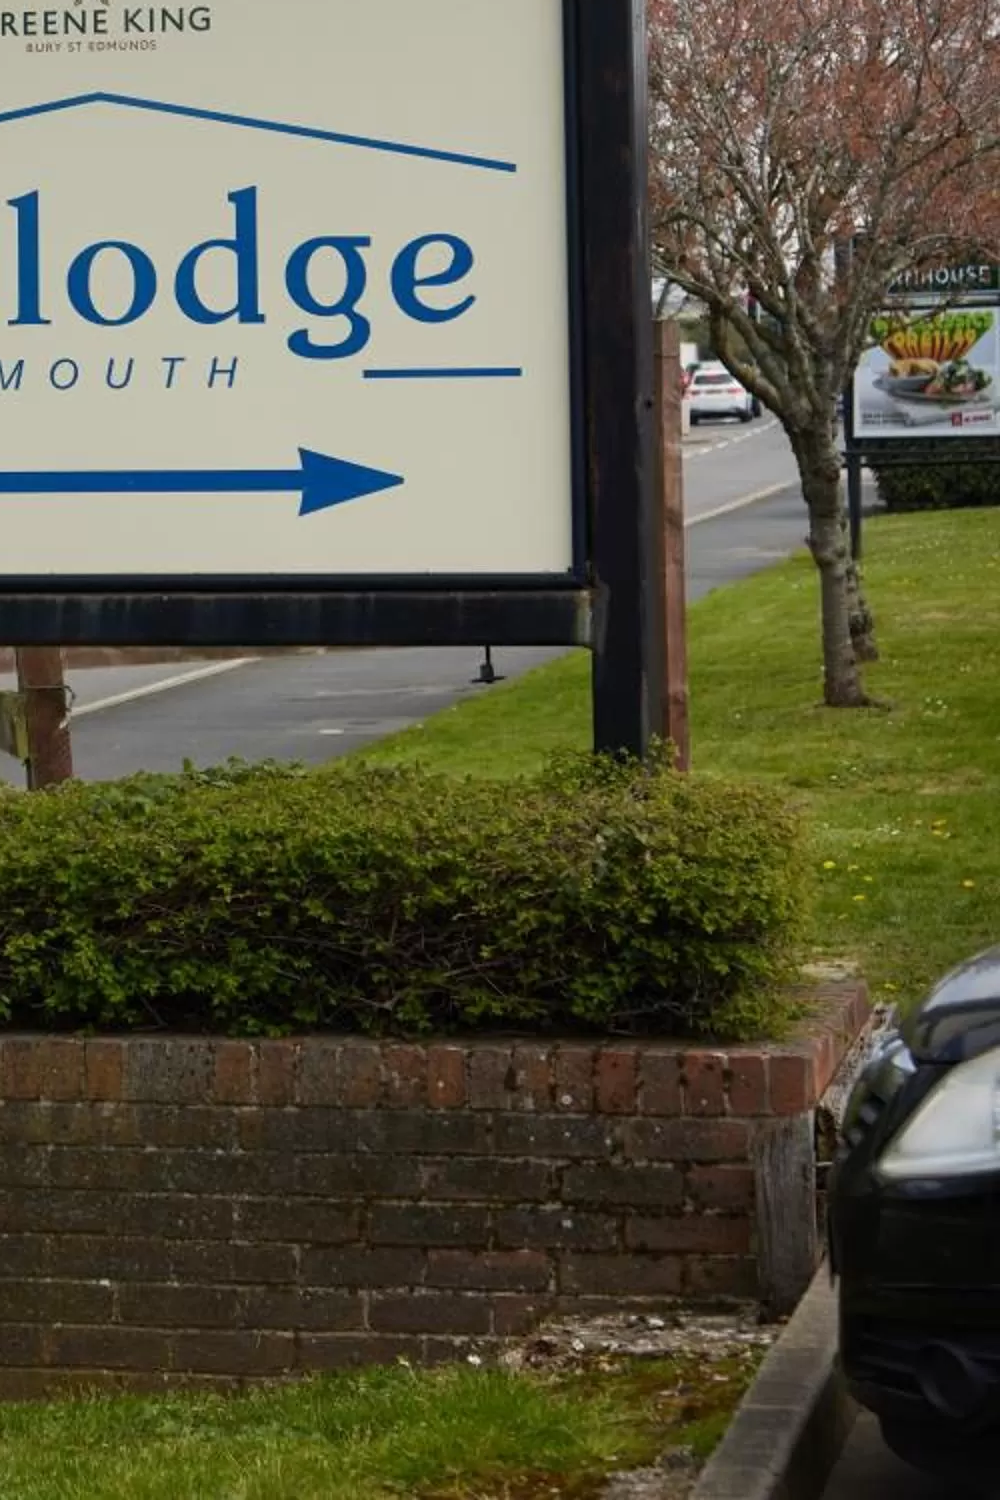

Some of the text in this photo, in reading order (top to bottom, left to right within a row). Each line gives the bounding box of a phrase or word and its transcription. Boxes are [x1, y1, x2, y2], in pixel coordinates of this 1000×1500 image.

[124, 6, 211, 33] KING
[26, 39, 157, 53] BURY ST EDMUNDS
